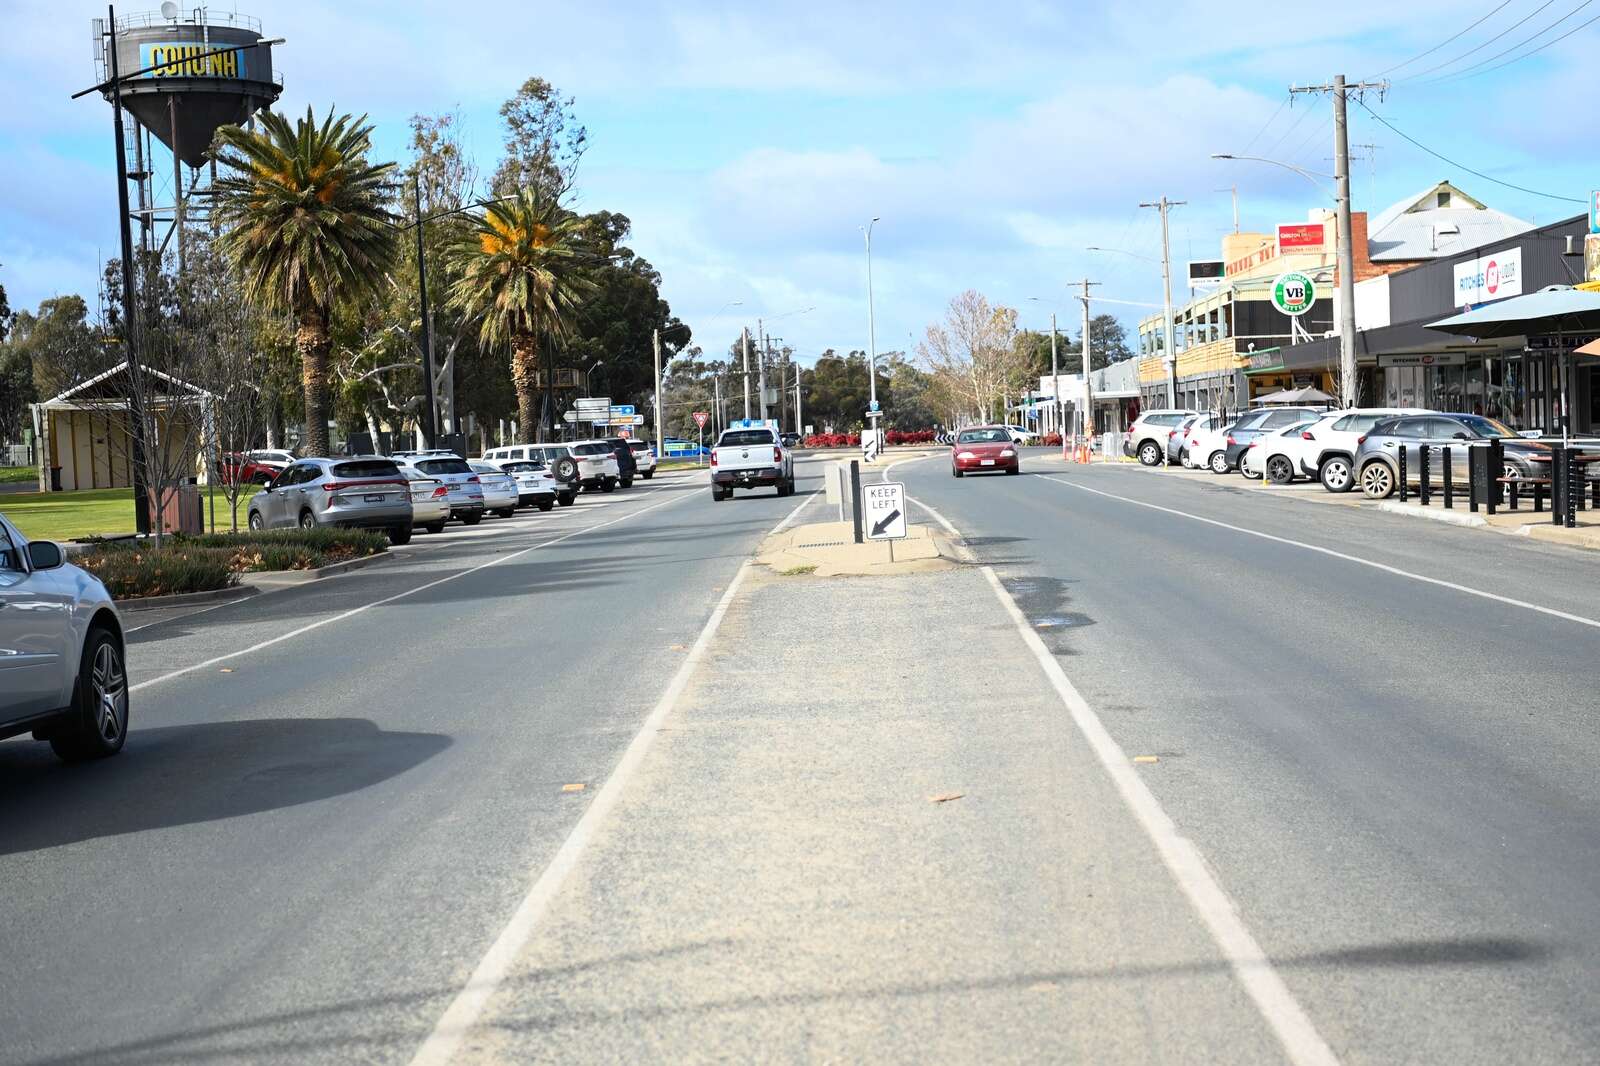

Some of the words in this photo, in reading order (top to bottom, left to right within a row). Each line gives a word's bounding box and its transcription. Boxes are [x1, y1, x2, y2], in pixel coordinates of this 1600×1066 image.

[150, 45, 237, 79] COHUNA
[1286, 288, 1304, 298] VB
[870, 488, 897, 498] KEEP
[872, 499, 896, 509] LEFT
